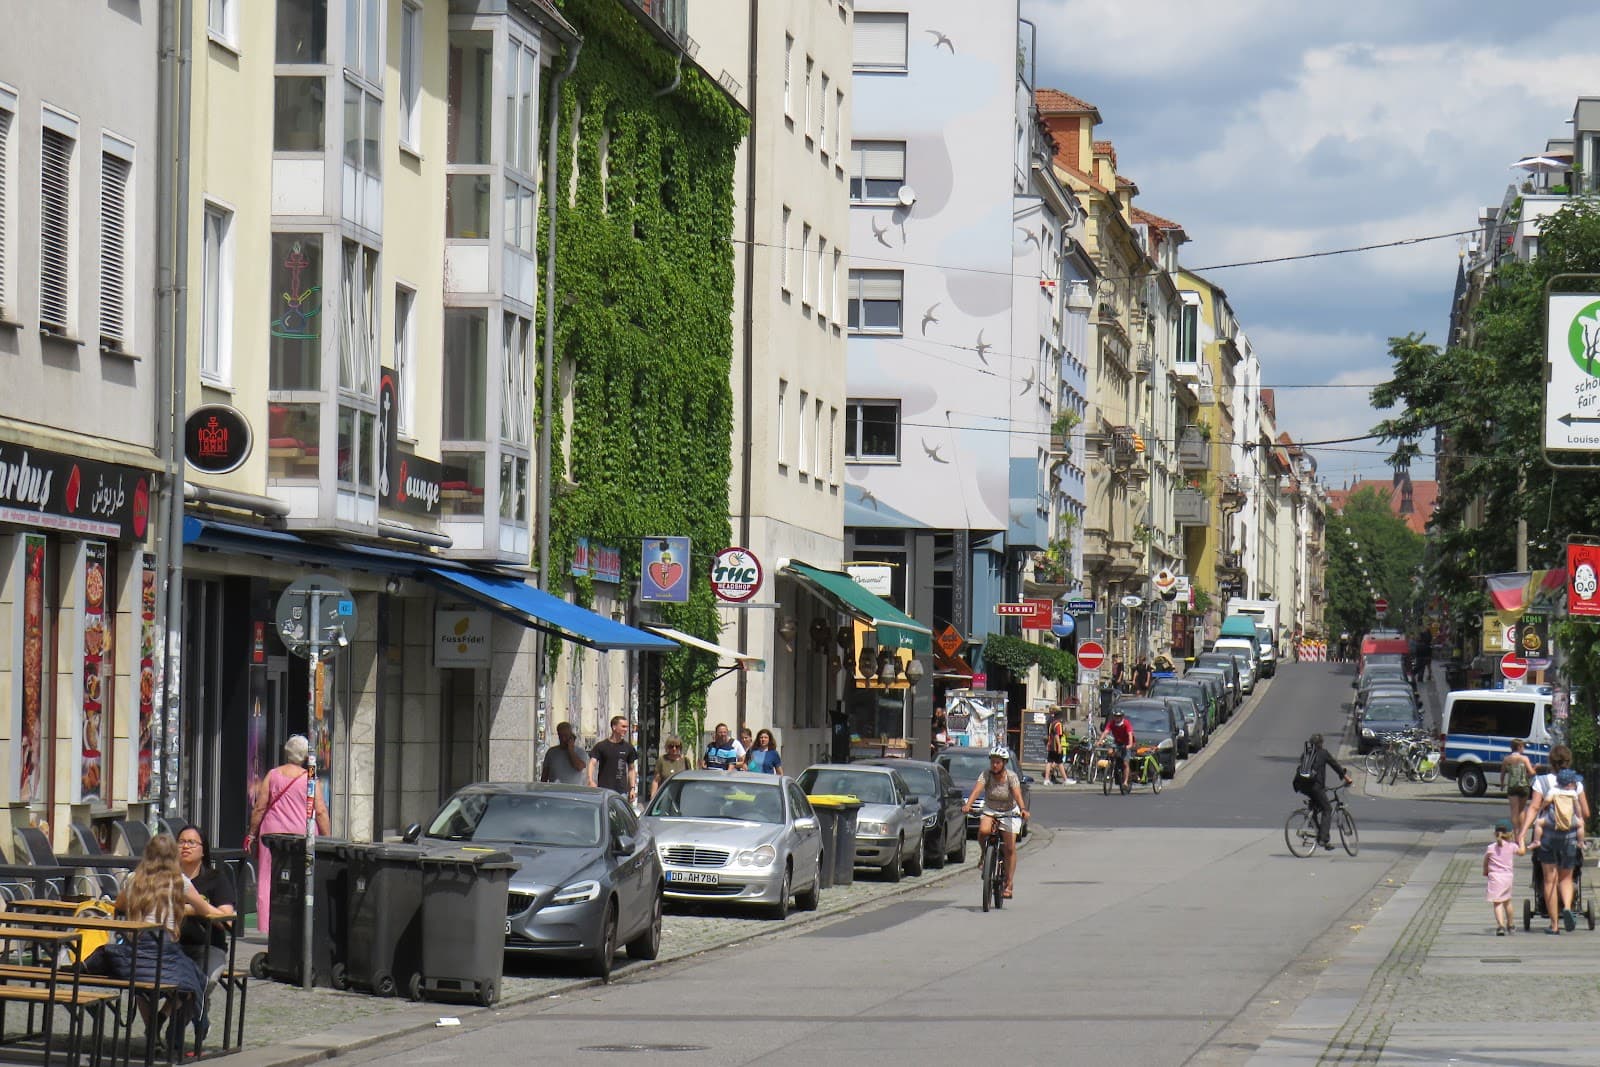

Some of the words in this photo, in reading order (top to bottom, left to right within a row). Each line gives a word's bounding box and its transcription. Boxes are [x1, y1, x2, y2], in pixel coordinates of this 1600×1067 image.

[1575, 376, 1600, 394] schö
[1578, 394, 1597, 408] fair
[0, 448, 53, 512] arbuş
[397, 460, 440, 511] Lounge
[714, 567, 756, 583] THC
[672, 872, 683, 881] DD
